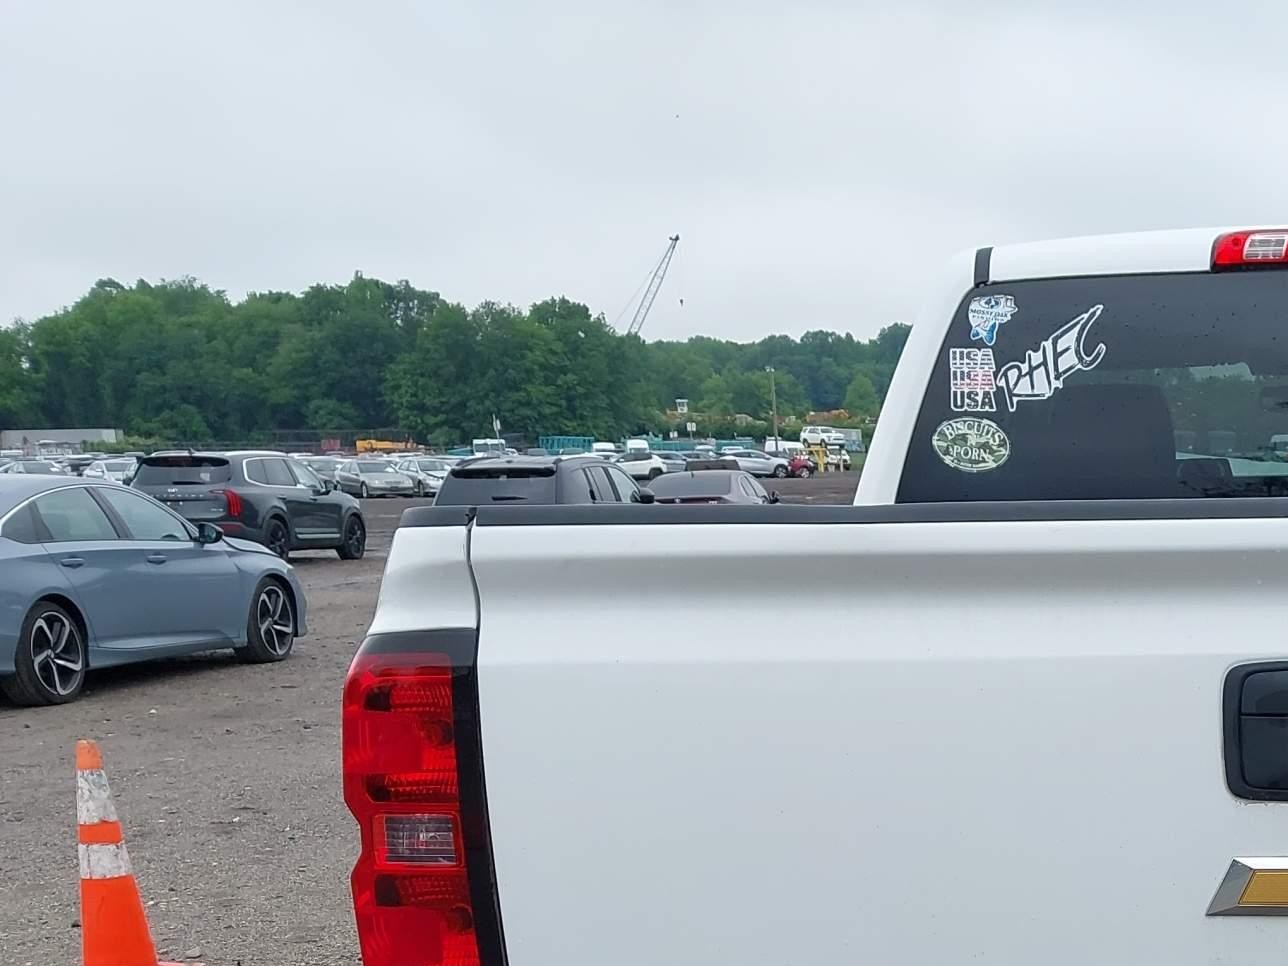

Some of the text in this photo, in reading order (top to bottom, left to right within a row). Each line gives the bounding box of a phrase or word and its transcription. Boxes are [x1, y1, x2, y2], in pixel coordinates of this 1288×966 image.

[951, 349, 996, 369] USA
[951, 369, 996, 390] USA
[951, 390, 997, 411] USA
[943, 421, 1004, 446] BISCUITS
[953, 445, 992, 462] PORN
